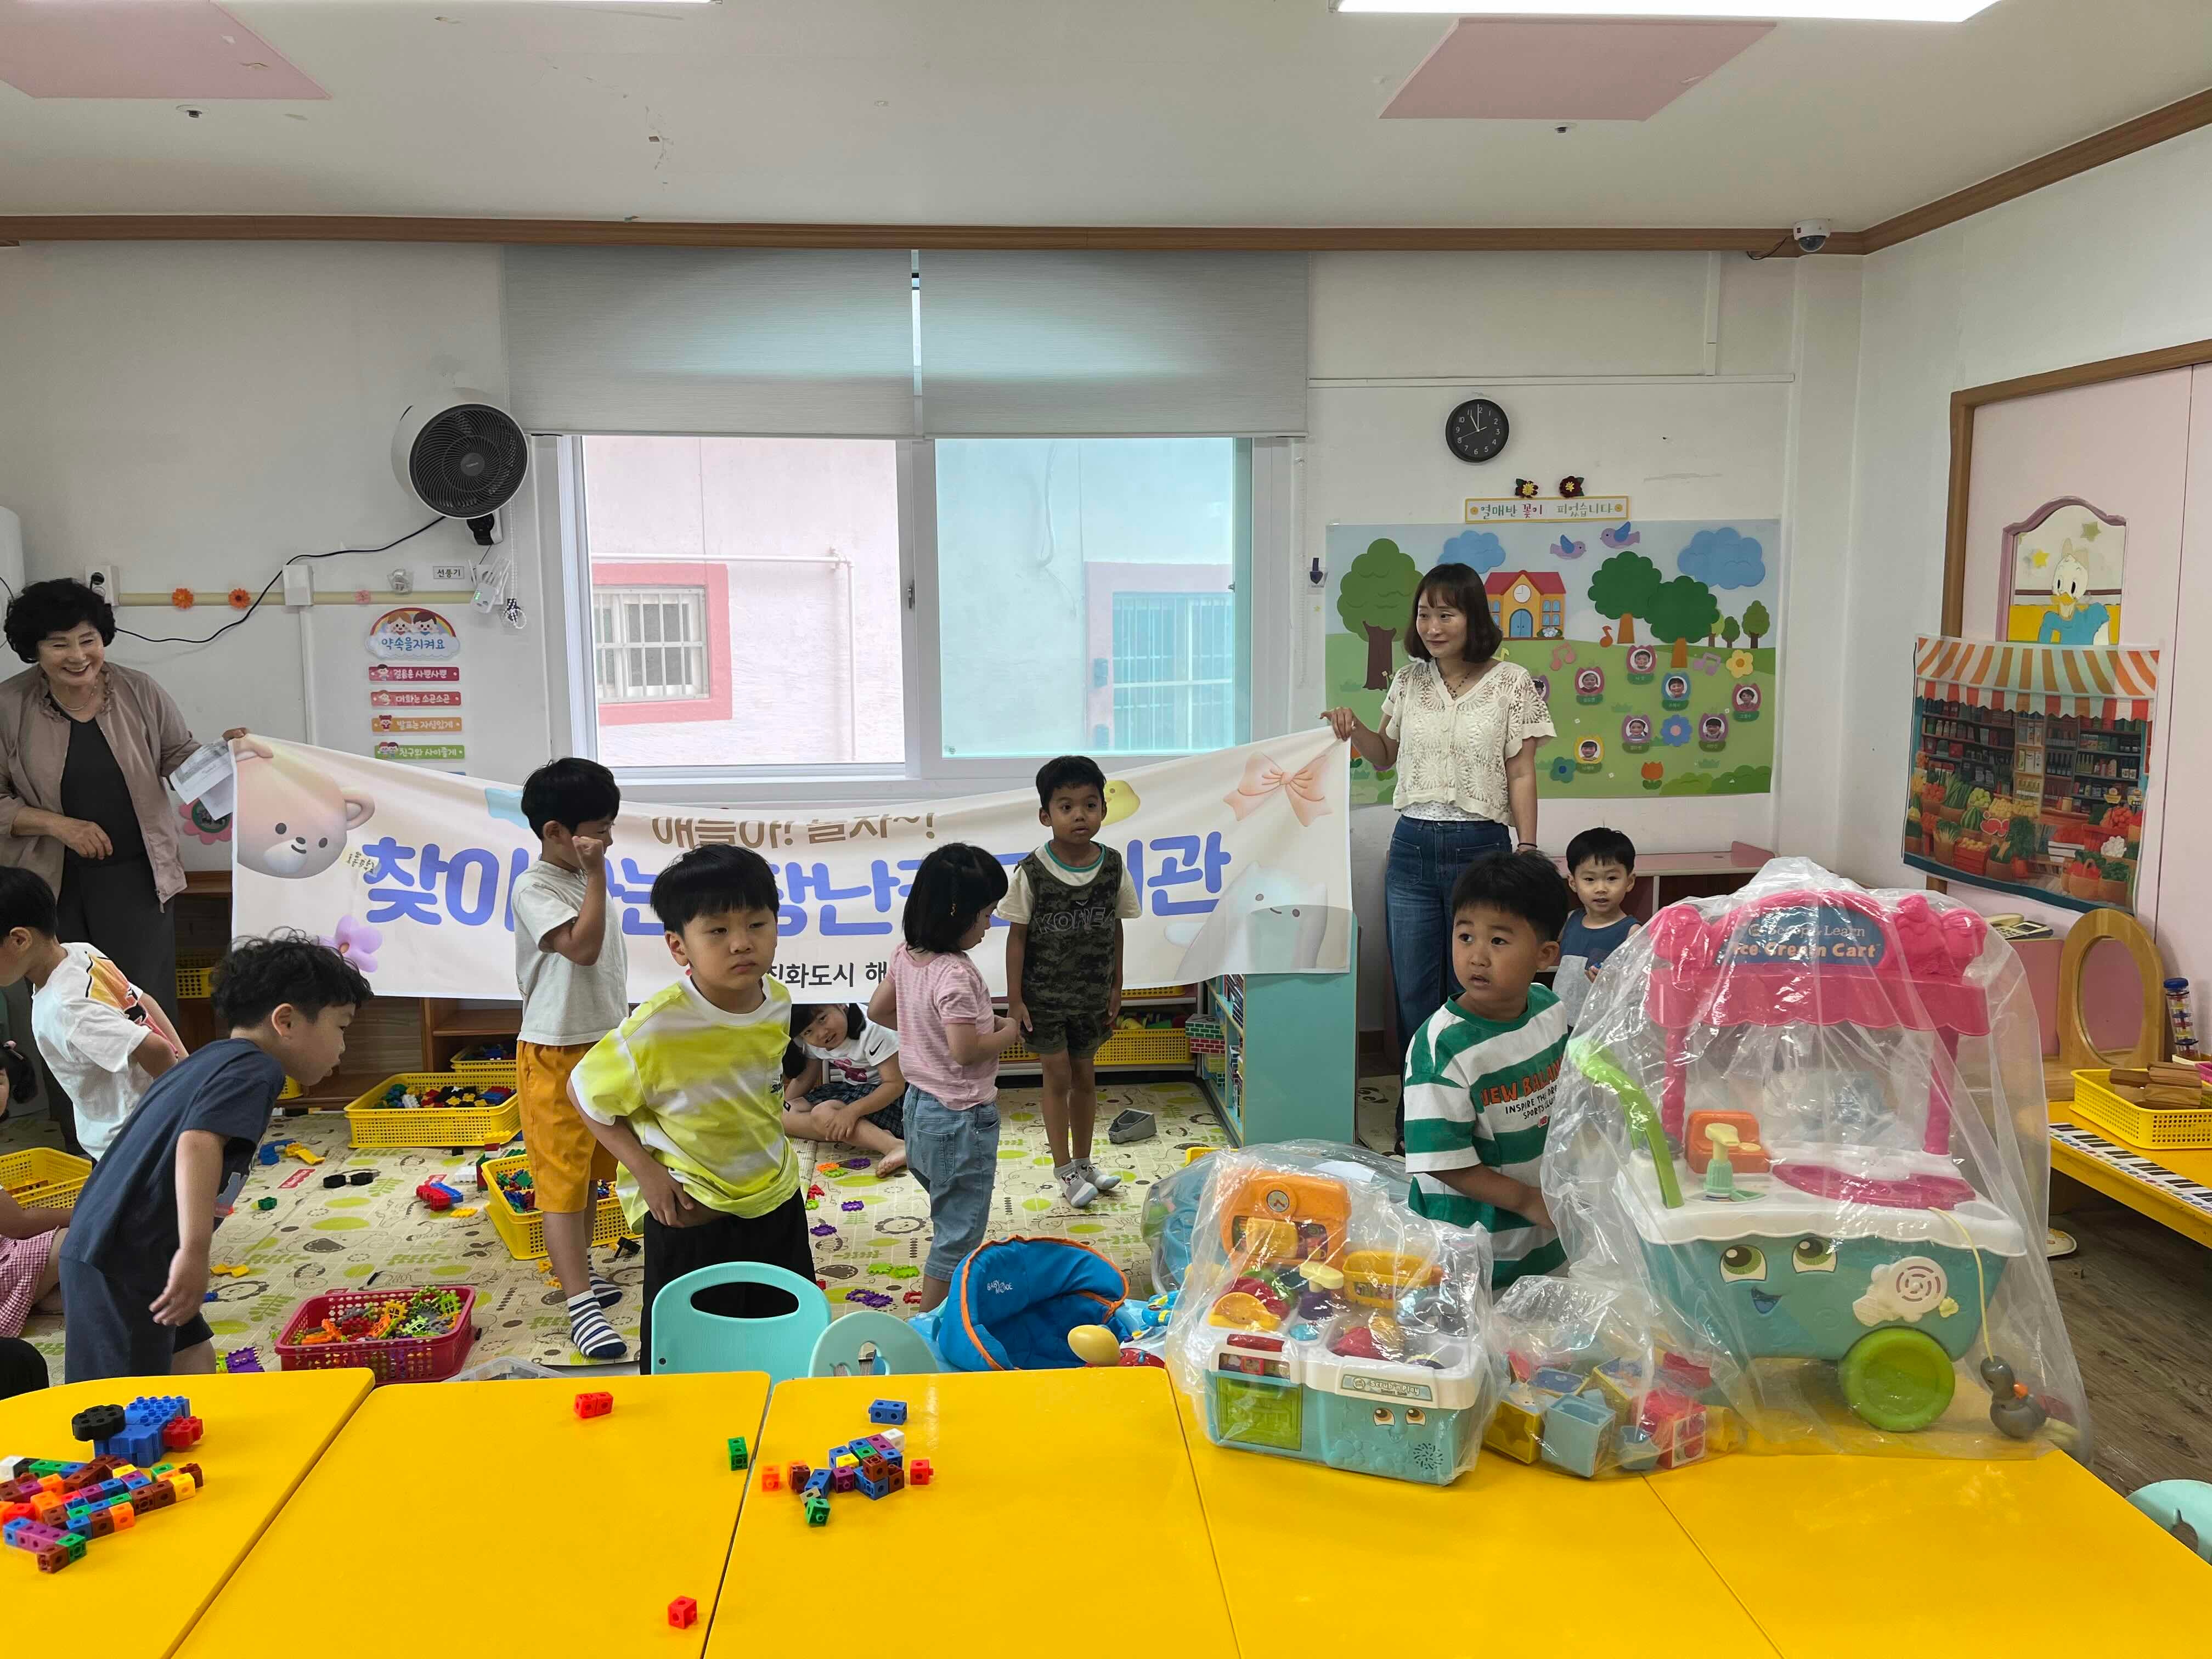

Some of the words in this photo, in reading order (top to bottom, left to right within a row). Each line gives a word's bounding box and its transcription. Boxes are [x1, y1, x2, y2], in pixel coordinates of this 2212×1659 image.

[1481, 504, 1517, 520] 열매반
[1522, 503, 1543, 518] 꽃이
[1557, 502, 1613, 517] 피었습니다
[437, 568, 461, 578] 선풍기
[381, 637, 445, 651] 약속을지켜요
[399, 748, 422, 757] 친구와
[1832, 942, 1876, 958] Cart
[1505, 1098, 1535, 1114] INSPIRE
[1523, 1103, 1544, 1120] SPORTS
